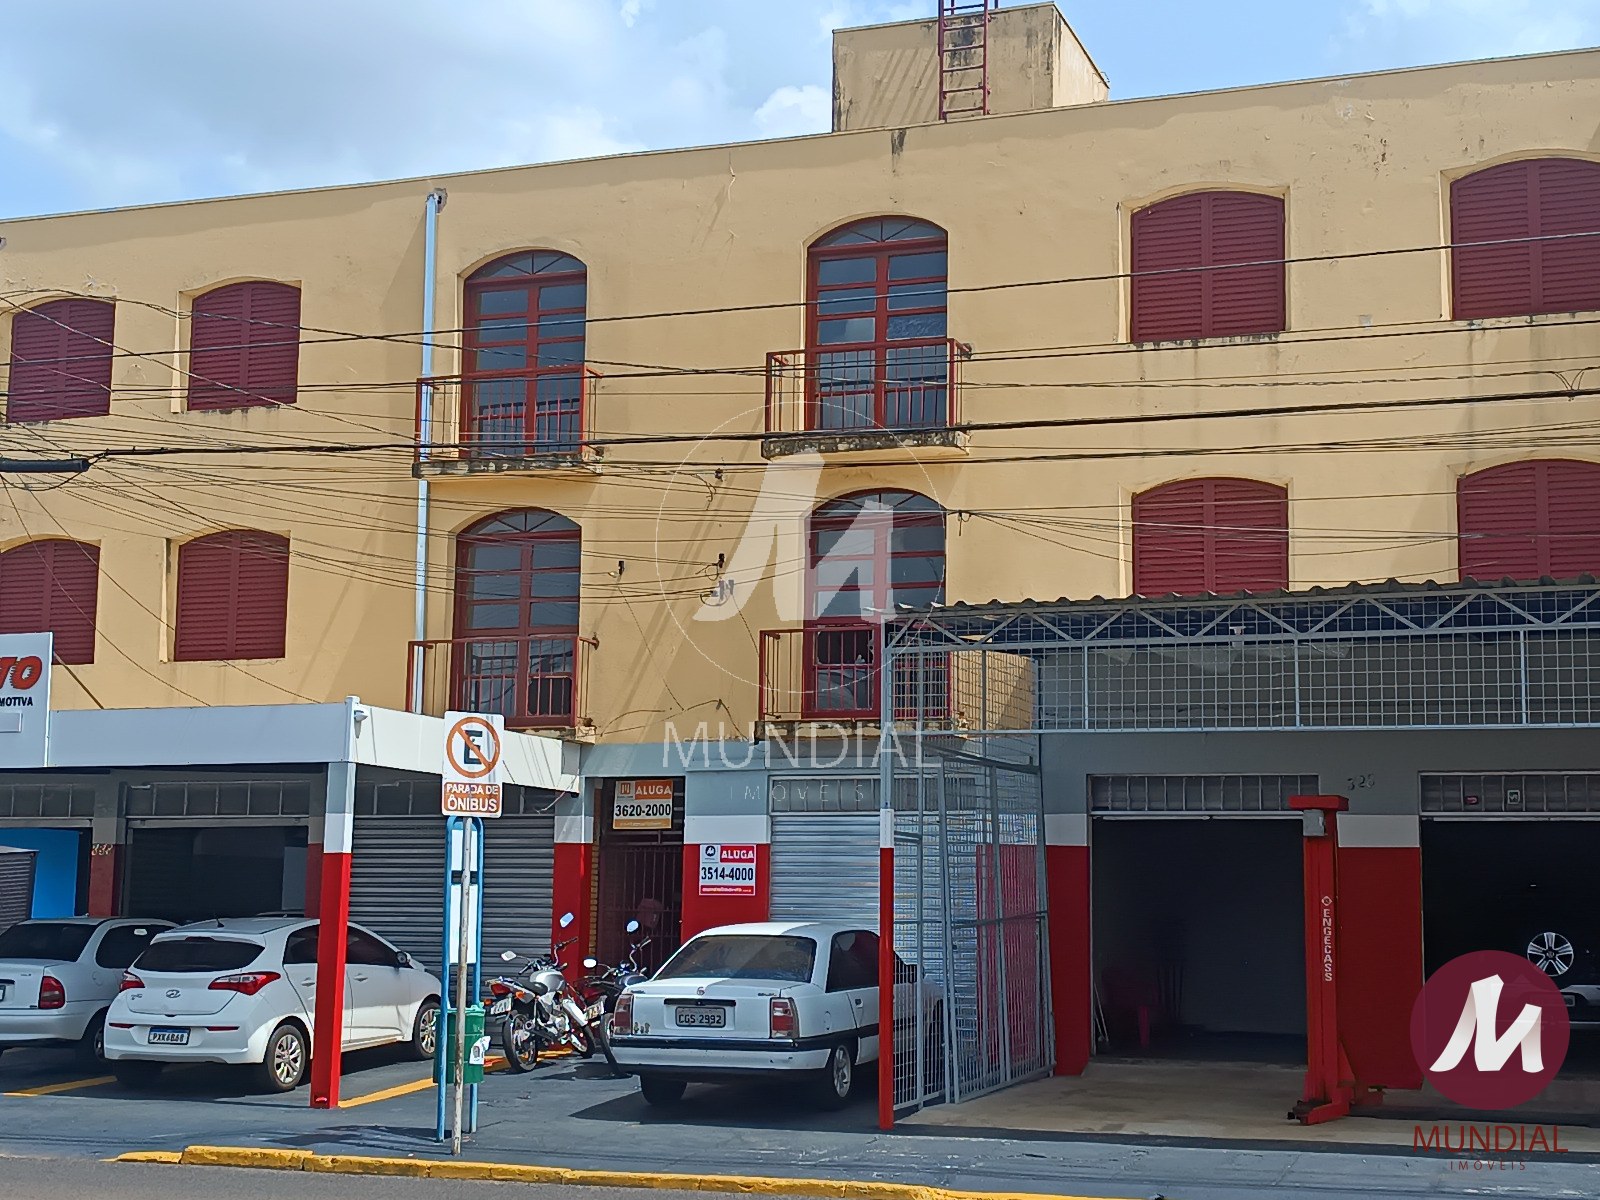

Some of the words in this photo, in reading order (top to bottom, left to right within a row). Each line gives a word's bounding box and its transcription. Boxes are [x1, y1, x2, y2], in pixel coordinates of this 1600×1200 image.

[446, 784, 483, 795] PARADA
[485, 785, 498, 795] DE
[636, 785, 672, 795] ALUGA
[447, 794, 497, 811] ÔNIBUS
[615, 803, 671, 817] 3620-2000
[721, 850, 754, 859] ALUGA
[701, 866, 753, 881] 3514-4000
[1323, 909, 1332, 981] ENGECASS
[678, 1014, 696, 1023] CGS
[699, 1014, 722, 1024] 2992
